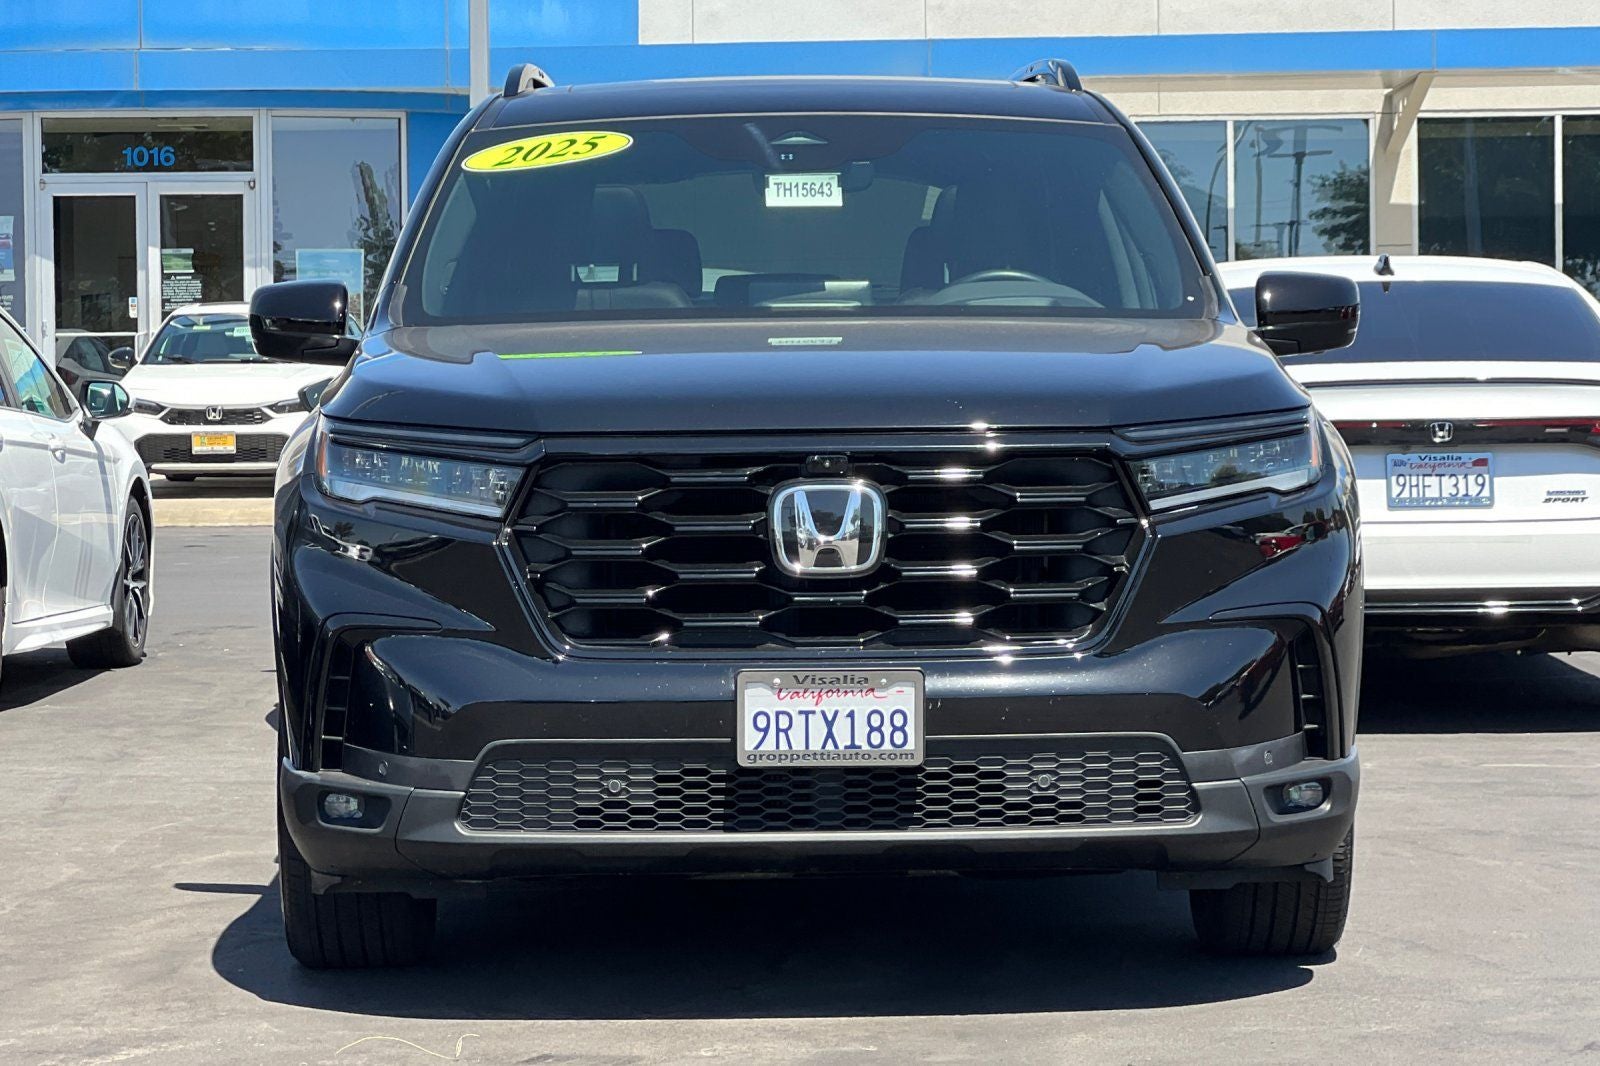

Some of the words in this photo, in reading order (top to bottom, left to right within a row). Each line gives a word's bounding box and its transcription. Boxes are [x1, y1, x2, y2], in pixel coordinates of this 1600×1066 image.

[122, 145, 175, 167] 1016
[491, 135, 607, 167] 2025
[773, 181, 833, 198] TH15643
[1418, 454, 1462, 462] Visalia
[1396, 473, 1486, 497] 9HFT319
[792, 674, 869, 685] Visalia
[776, 687, 888, 706] California
[752, 708, 909, 750] 9RTX188
[746, 751, 915, 764] groppettiauto.com
